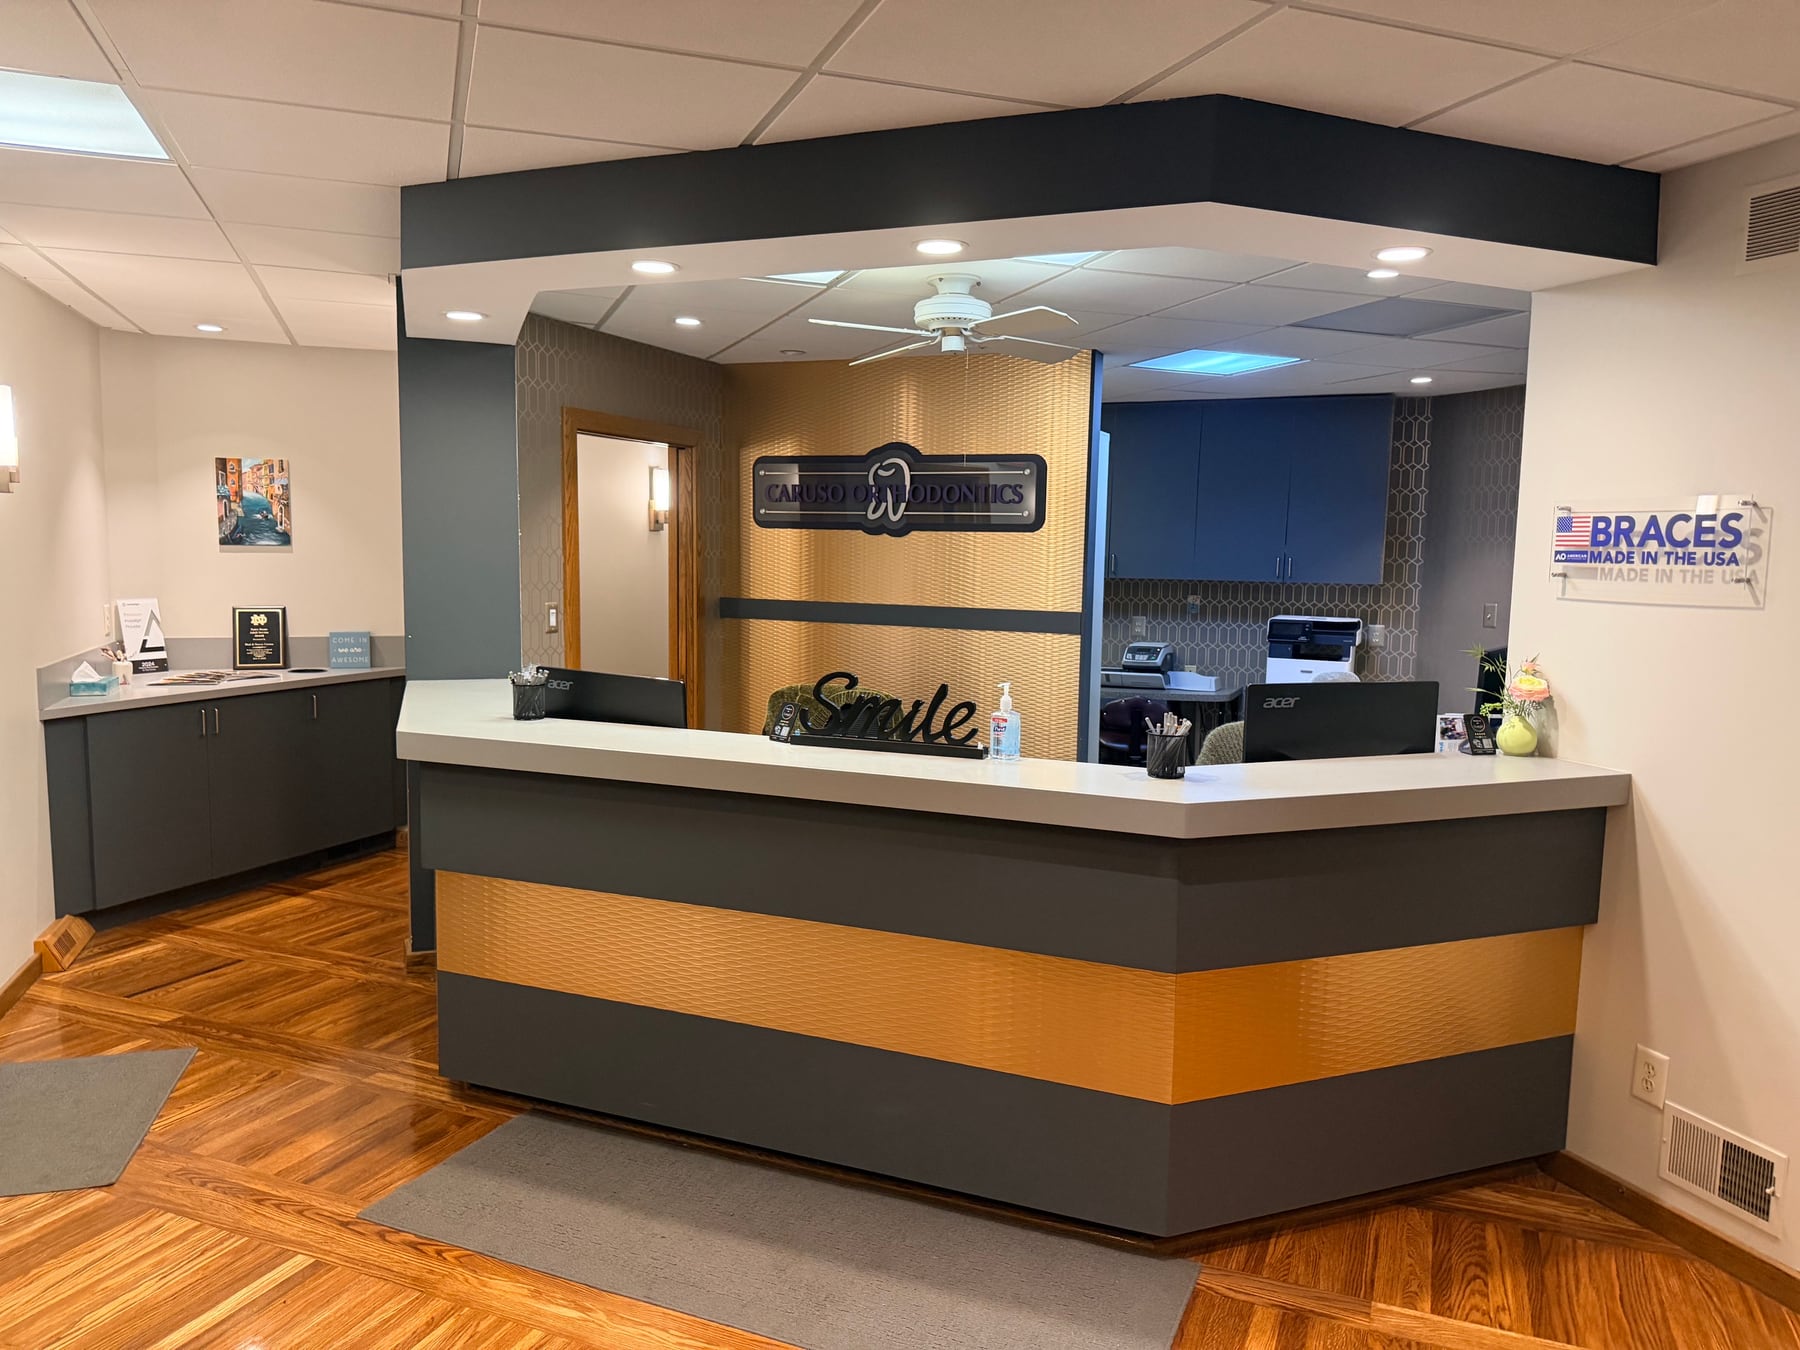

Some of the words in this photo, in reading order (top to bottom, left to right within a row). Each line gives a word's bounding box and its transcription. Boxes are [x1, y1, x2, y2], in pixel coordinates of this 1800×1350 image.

[766, 483, 846, 504] CARUSO
[853, 483, 1025, 505] ORTHODONTICS
[1590, 512, 1744, 549] BRACES
[1589, 550, 1635, 565] MADE
[1641, 551, 1658, 565] IN
[1664, 551, 1697, 566] THE
[1703, 552, 1740, 567] USA
[332, 636, 355, 644] COME
[359, 636, 368, 644] IN
[331, 656, 369, 664] AWESOME
[547, 679, 574, 691] acer
[800, 671, 979, 745] Smile
[1263, 697, 1301, 709] acer
